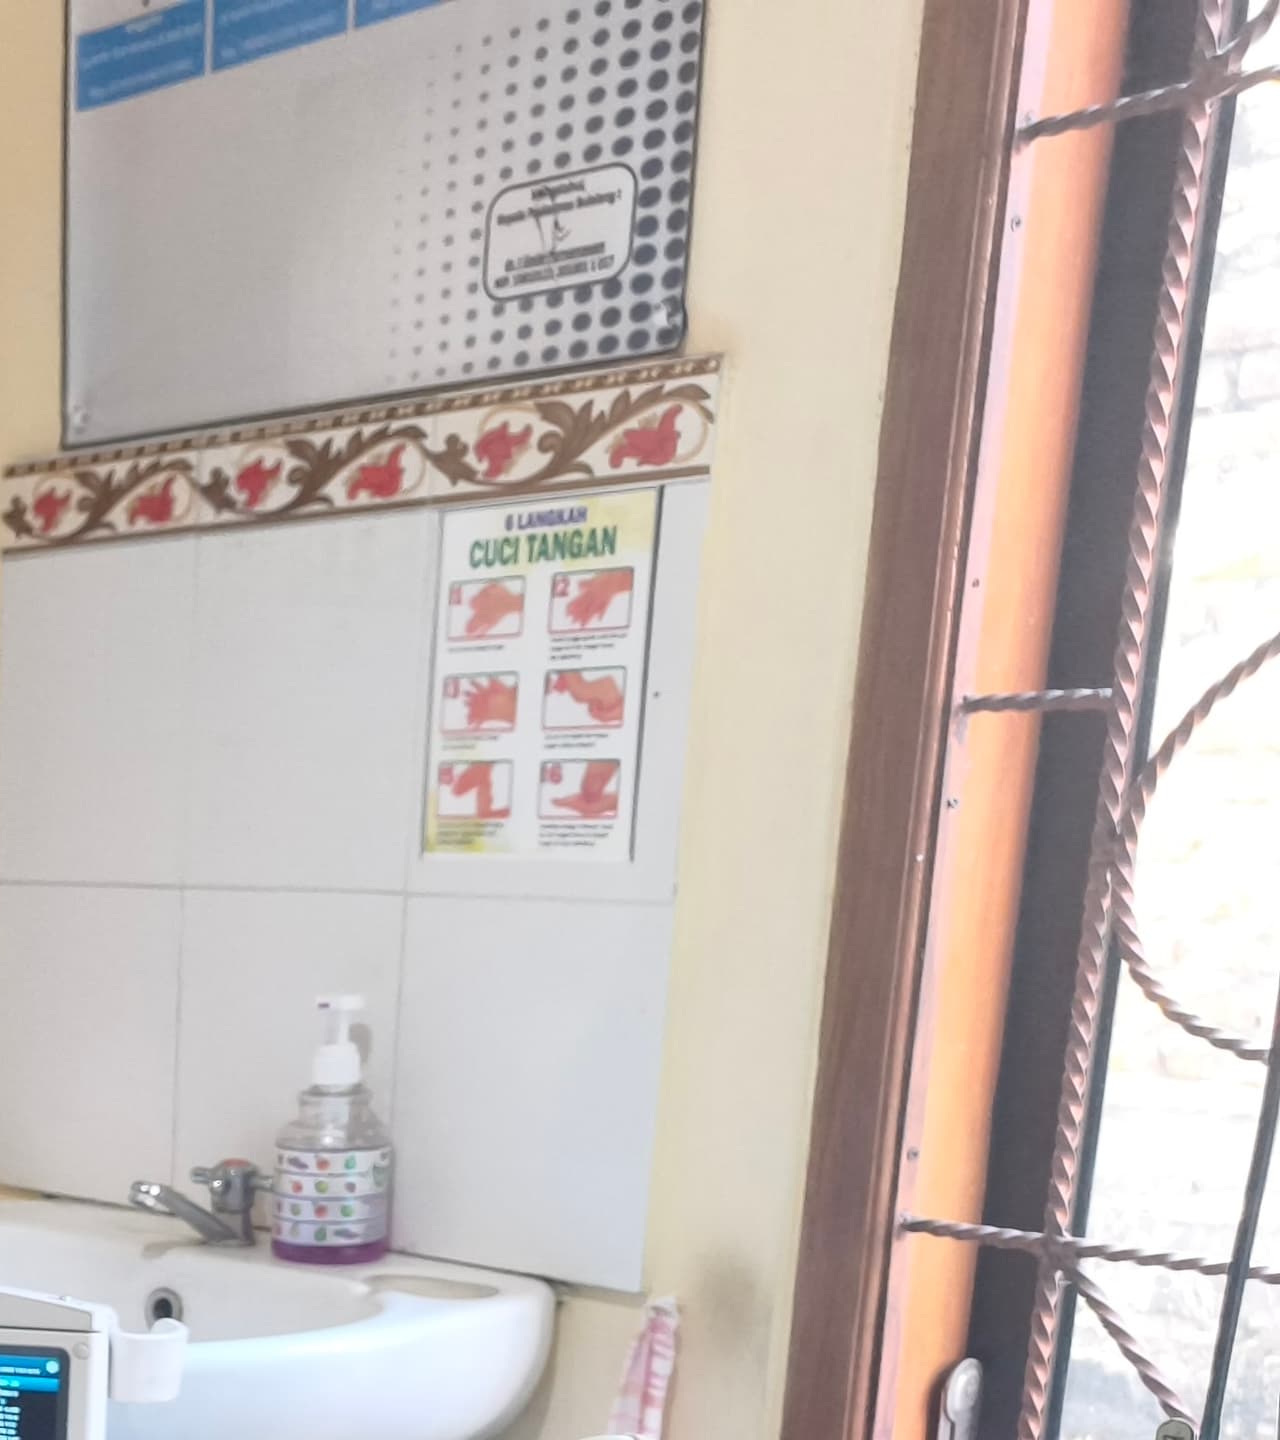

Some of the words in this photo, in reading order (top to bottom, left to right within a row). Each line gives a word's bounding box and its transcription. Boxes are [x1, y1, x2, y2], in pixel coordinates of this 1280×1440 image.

[517, 507, 587, 530] LANGKAH
[469, 537, 519, 568] CUCI
[527, 526, 617, 563] TANGAN
